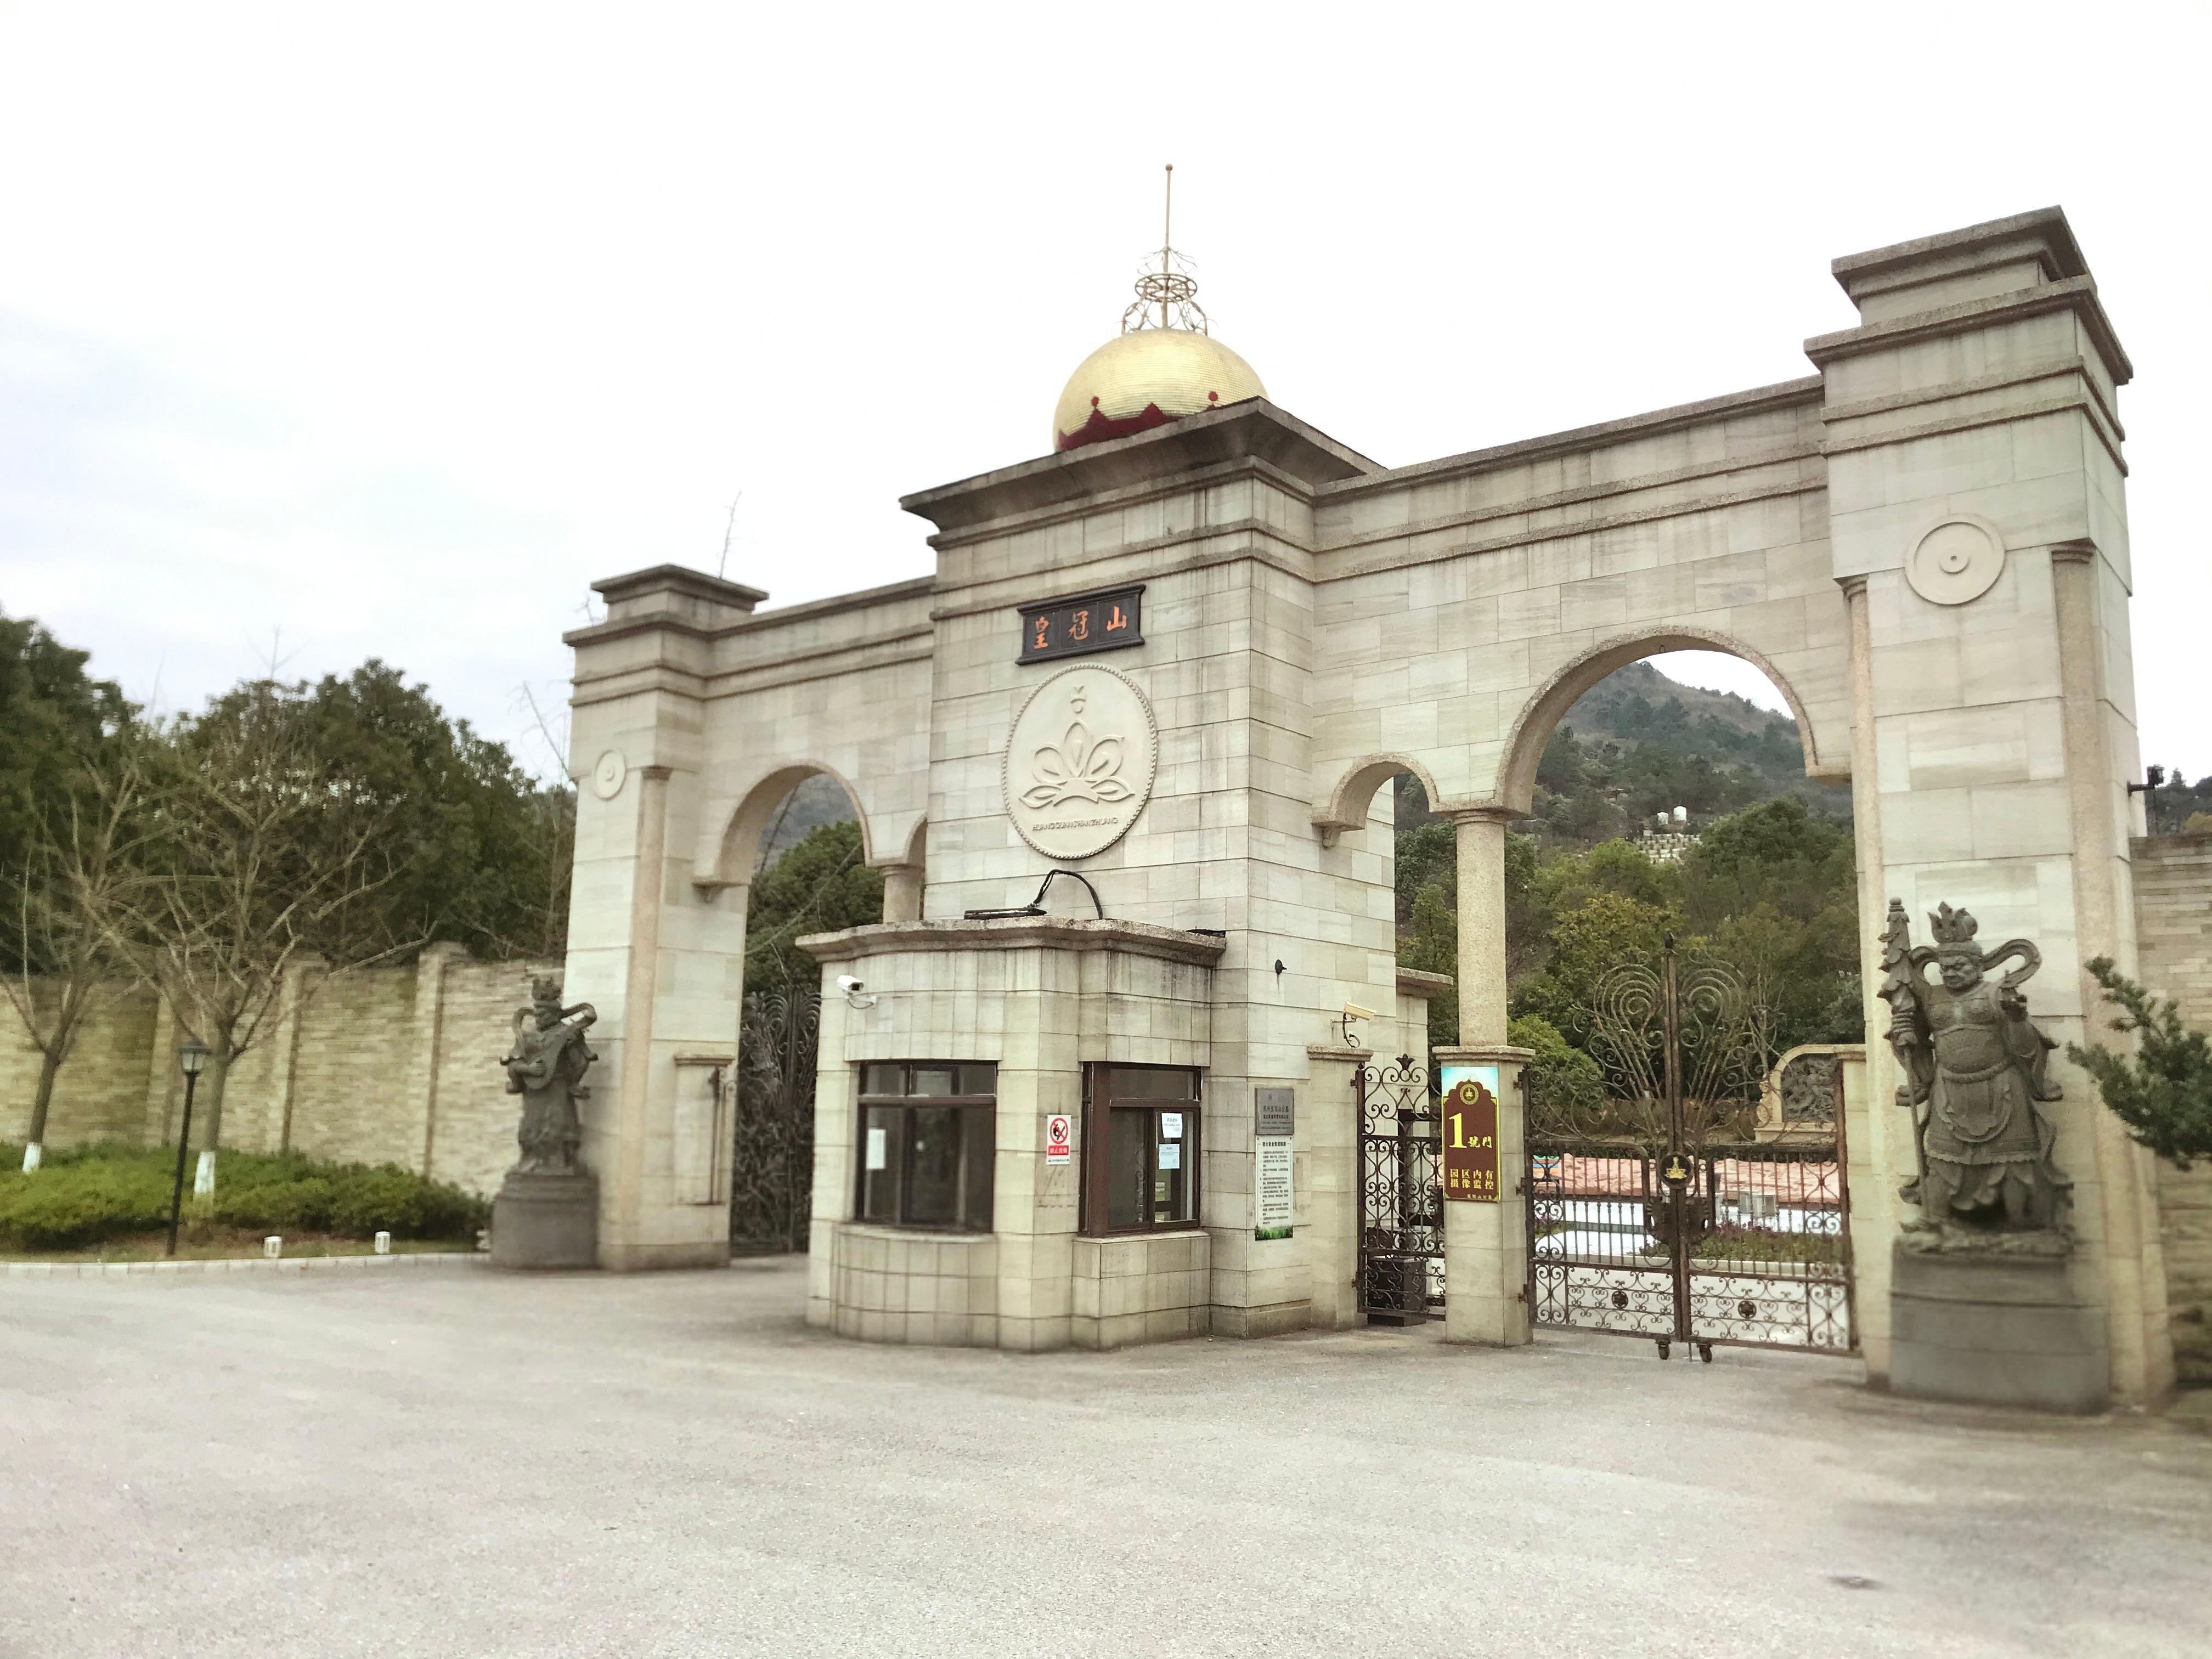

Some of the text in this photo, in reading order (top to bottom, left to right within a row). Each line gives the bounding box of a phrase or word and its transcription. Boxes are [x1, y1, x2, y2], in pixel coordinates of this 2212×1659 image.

[1033, 606, 1127, 649] 皇冠山
[1450, 1168, 1494, 1180] 园区内有
[1450, 1178, 1494, 1190] 摄像监控
